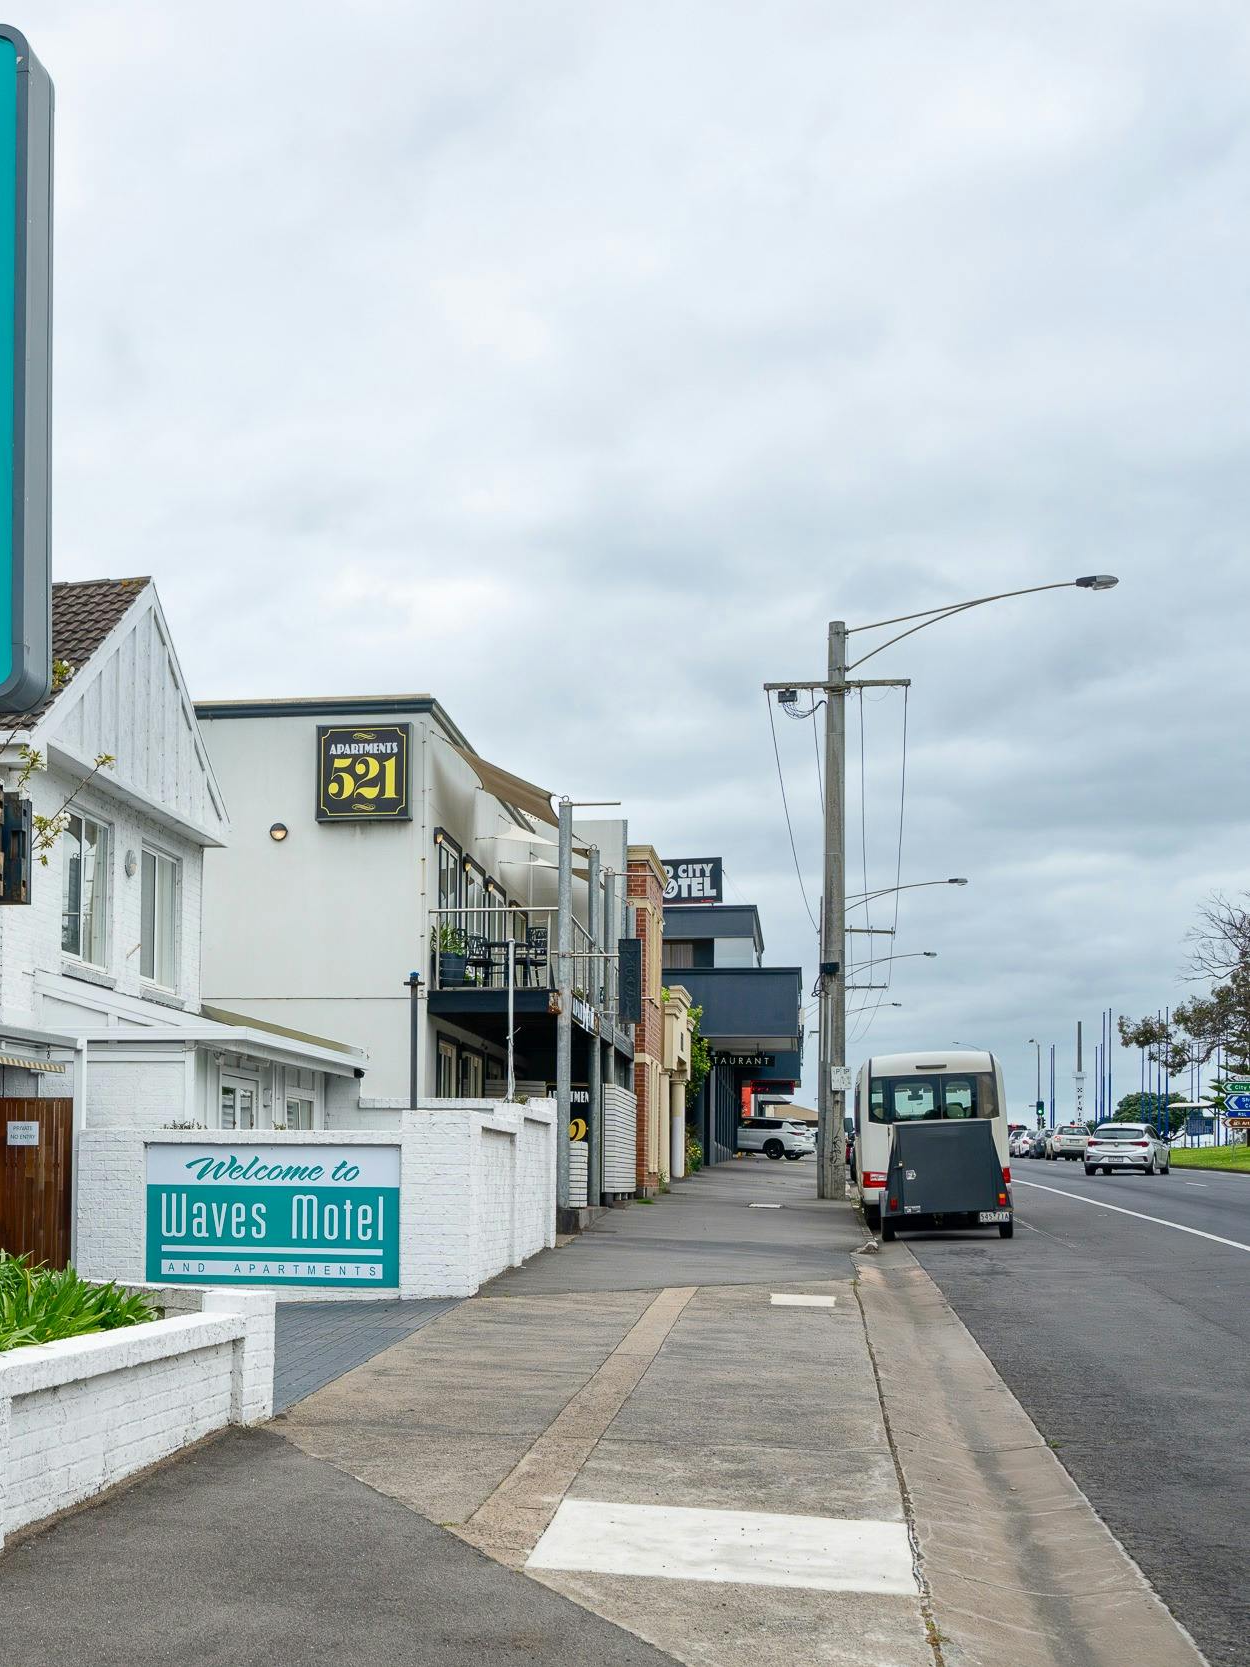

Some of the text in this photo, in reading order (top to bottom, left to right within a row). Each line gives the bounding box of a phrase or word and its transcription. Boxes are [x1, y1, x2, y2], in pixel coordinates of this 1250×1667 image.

[329, 742, 399, 755] APARTMENTS
[328, 755, 400, 800] 521
[678, 863, 713, 878] CITY
[662, 876, 717, 899] OTEL
[713, 1056, 770, 1065] TAURANT
[185, 1155, 361, 1182] Welcome to
[161, 1192, 384, 1241] Waves Motel
[167, 1262, 377, 1276] AND APARTMENTS
